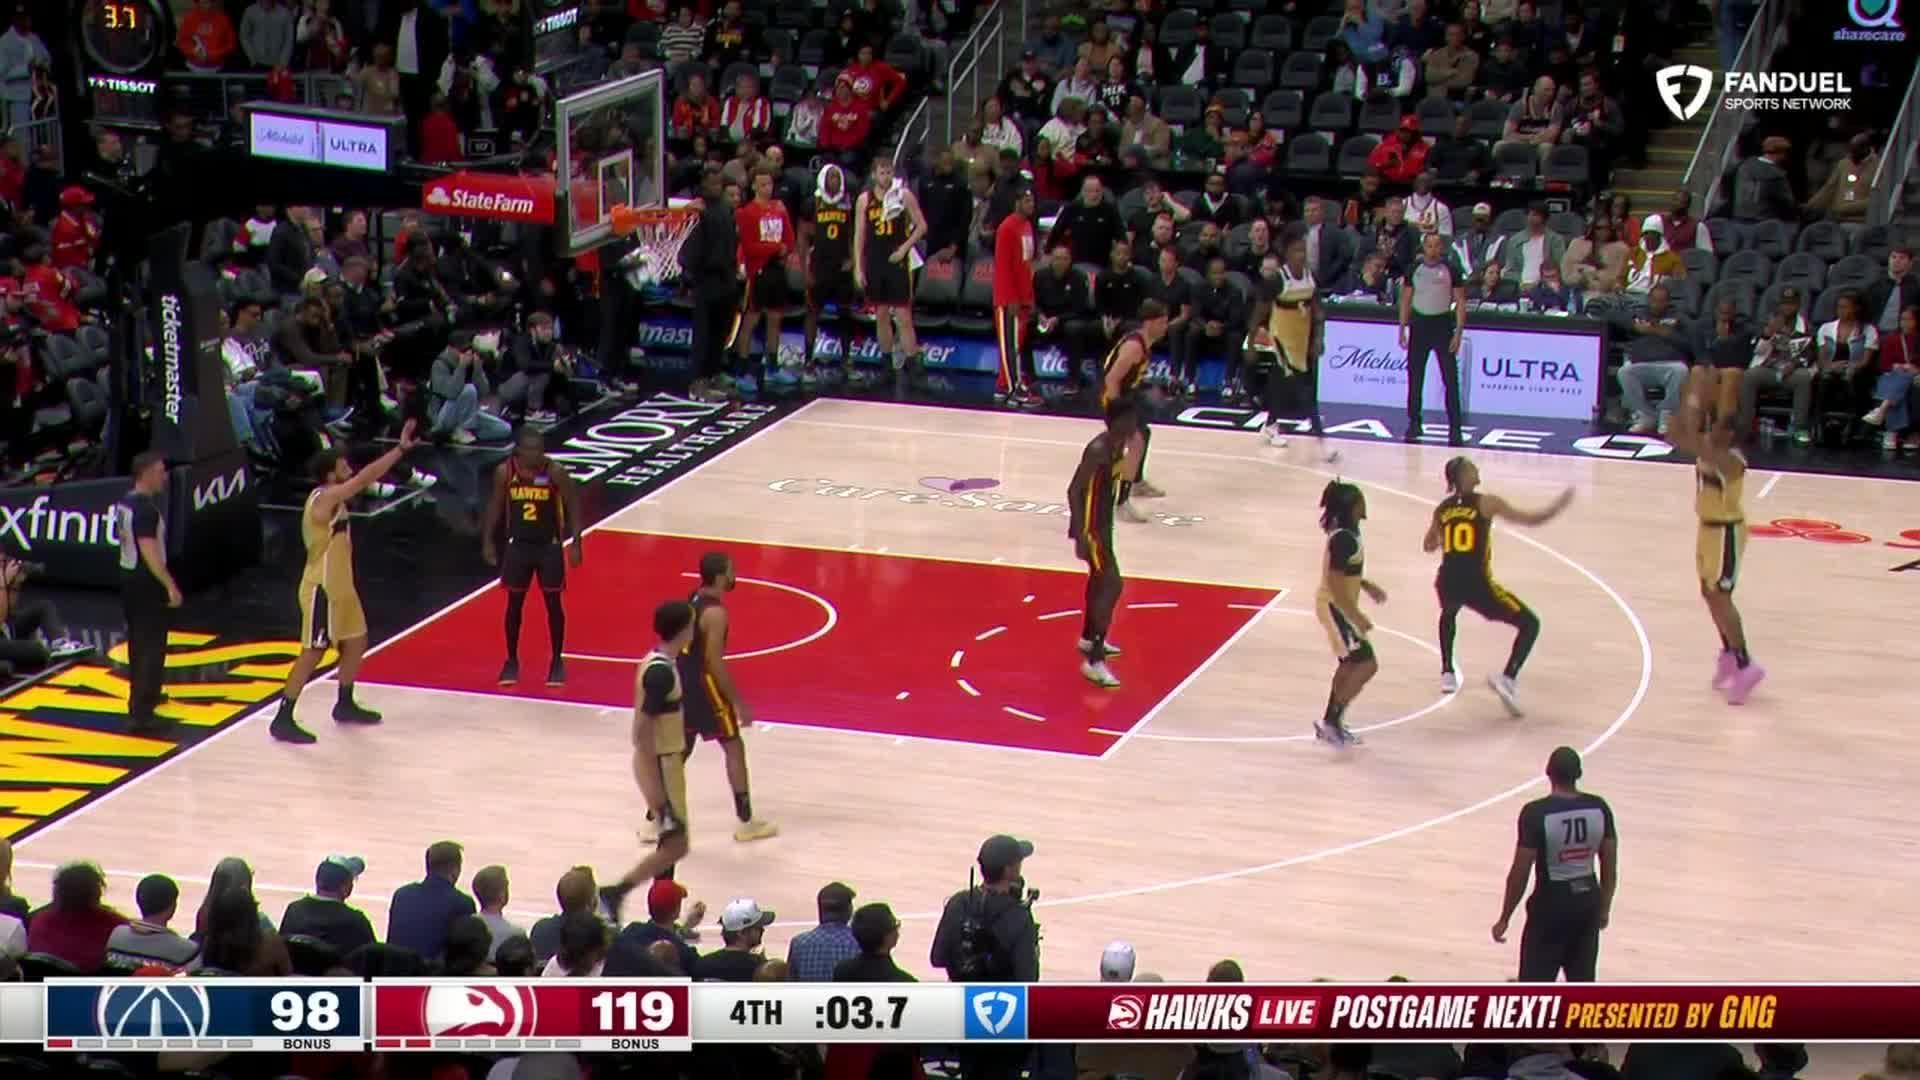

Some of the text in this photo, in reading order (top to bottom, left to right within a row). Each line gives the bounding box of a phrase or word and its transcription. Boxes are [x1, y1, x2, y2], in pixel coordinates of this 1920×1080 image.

[103, 4, 136, 29] 3.7
[1833, 27, 1906, 42] sharecare
[106, 78, 157, 94] TISSOT
[330, 137, 377, 155] ULTRA
[827, 223, 839, 240] 0
[875, 221, 893, 235] 31
[161, 294, 182, 425] ticketmaster
[1482, 357, 1581, 382] ULTRA
[607, 403, 777, 486] HEALTHCARE
[511, 486, 550, 500] HAWKS
[0, 495, 120, 550] xfinit
[522, 502, 537, 521] 2
[1444, 522, 1475, 552] 10
[1561, 816, 1588, 846] 70
